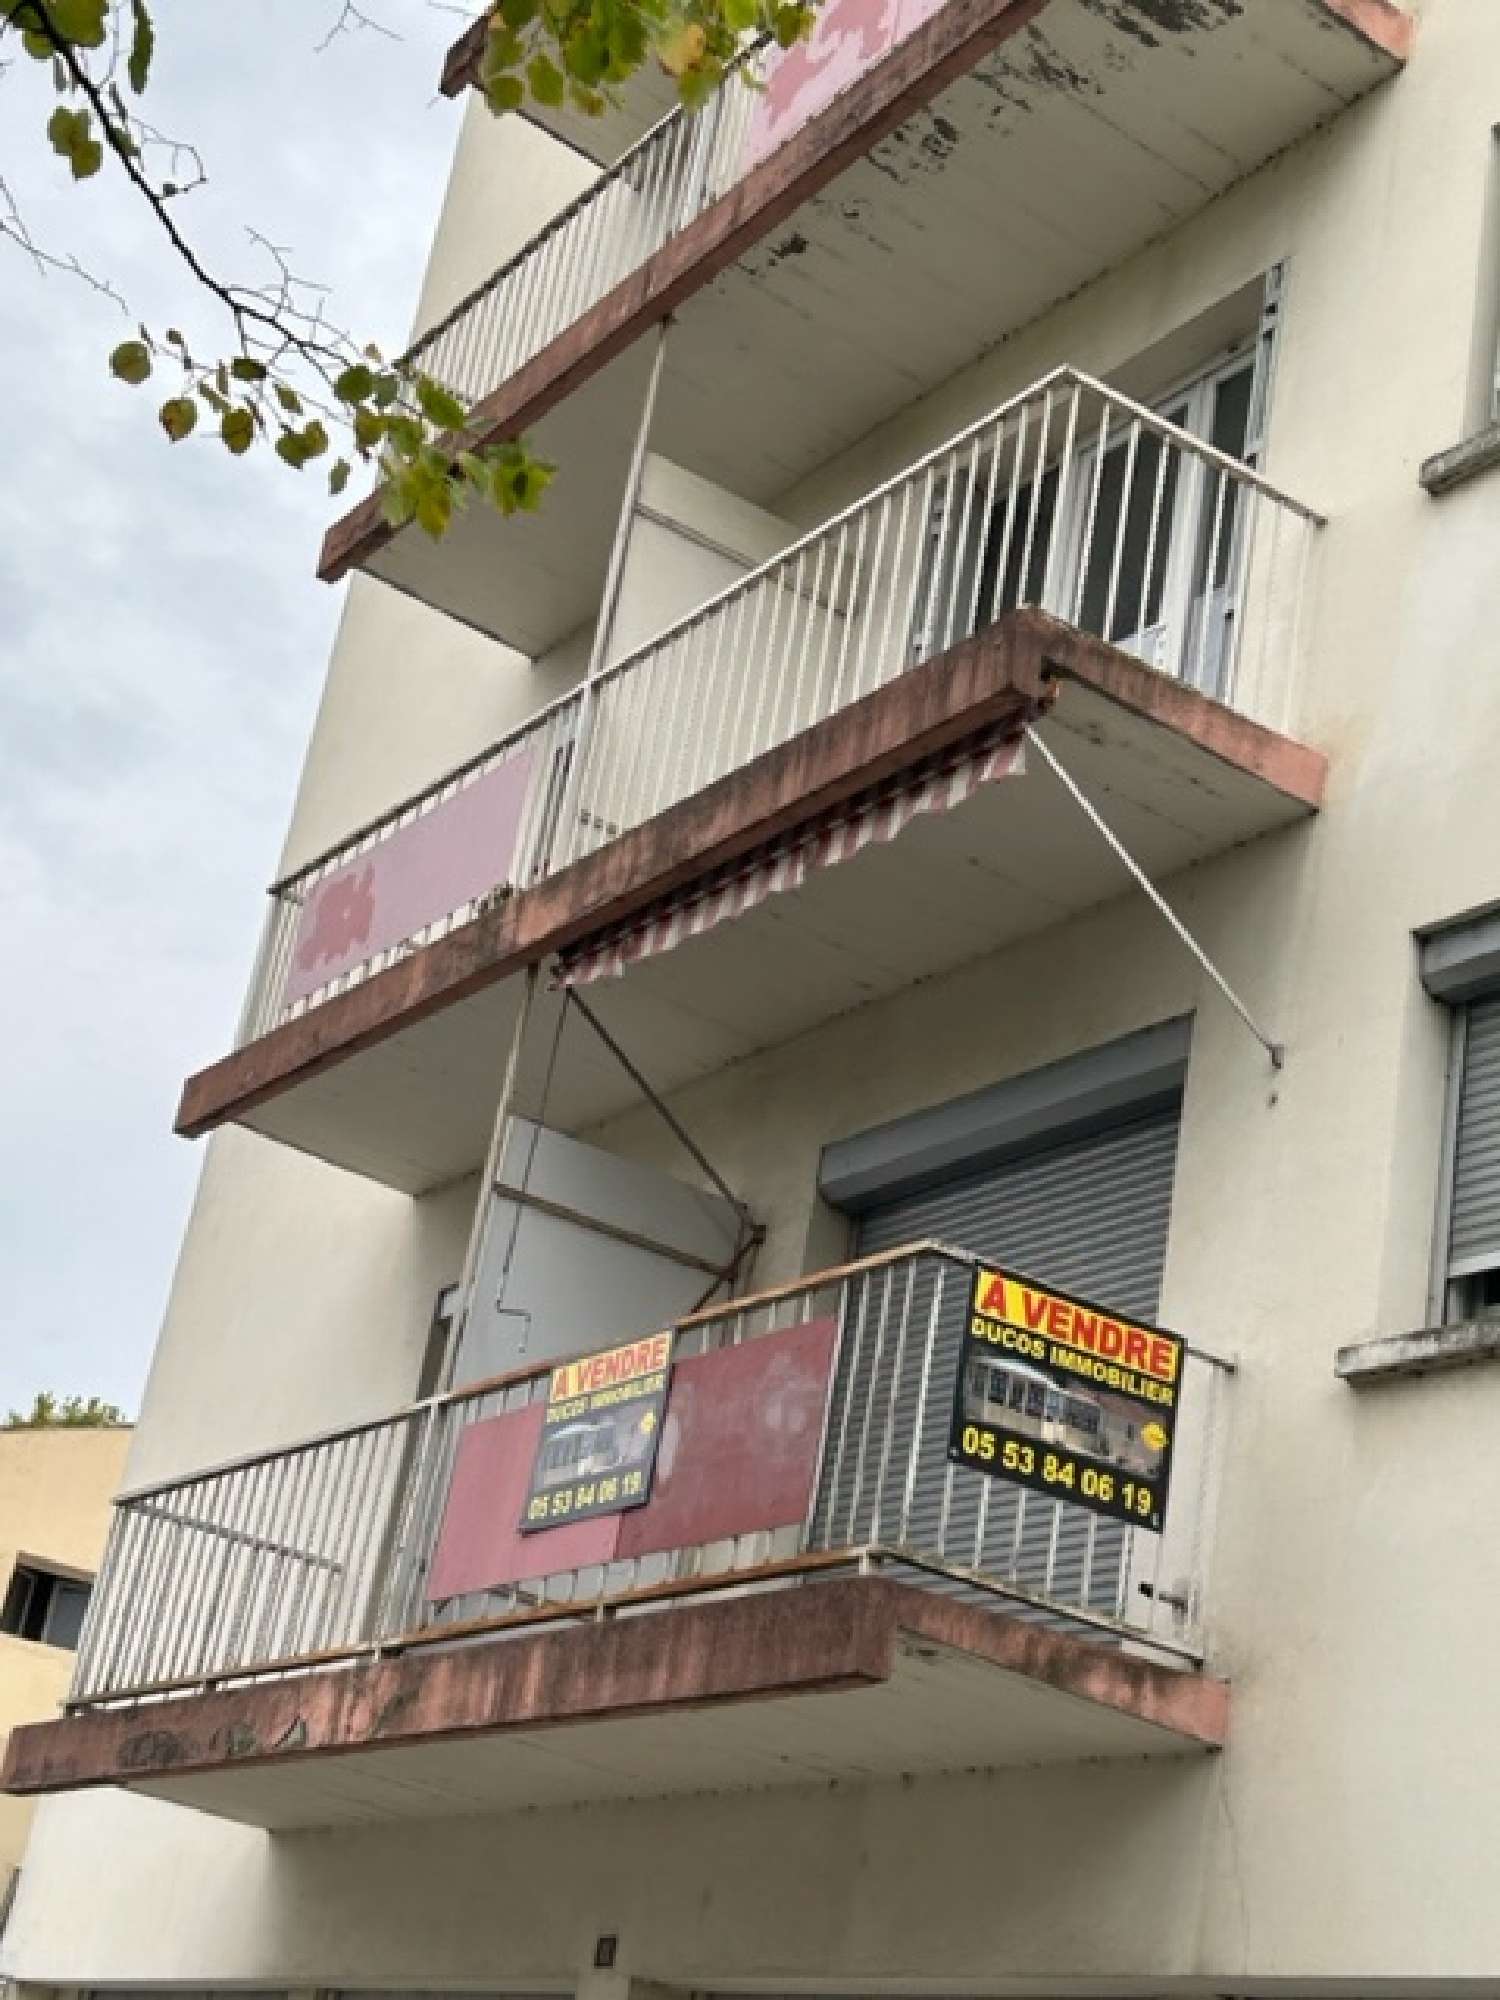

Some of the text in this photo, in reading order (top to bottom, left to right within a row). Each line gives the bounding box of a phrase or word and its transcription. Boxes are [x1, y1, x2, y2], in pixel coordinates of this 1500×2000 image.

[579, 1336, 667, 1394] VENDRE
[971, 1318, 1174, 1407] DUCOS IMMOBILIER
[1023, 1288, 1173, 1379] VENDRE
[962, 1425, 1153, 1518] 05 53 84 06 19
